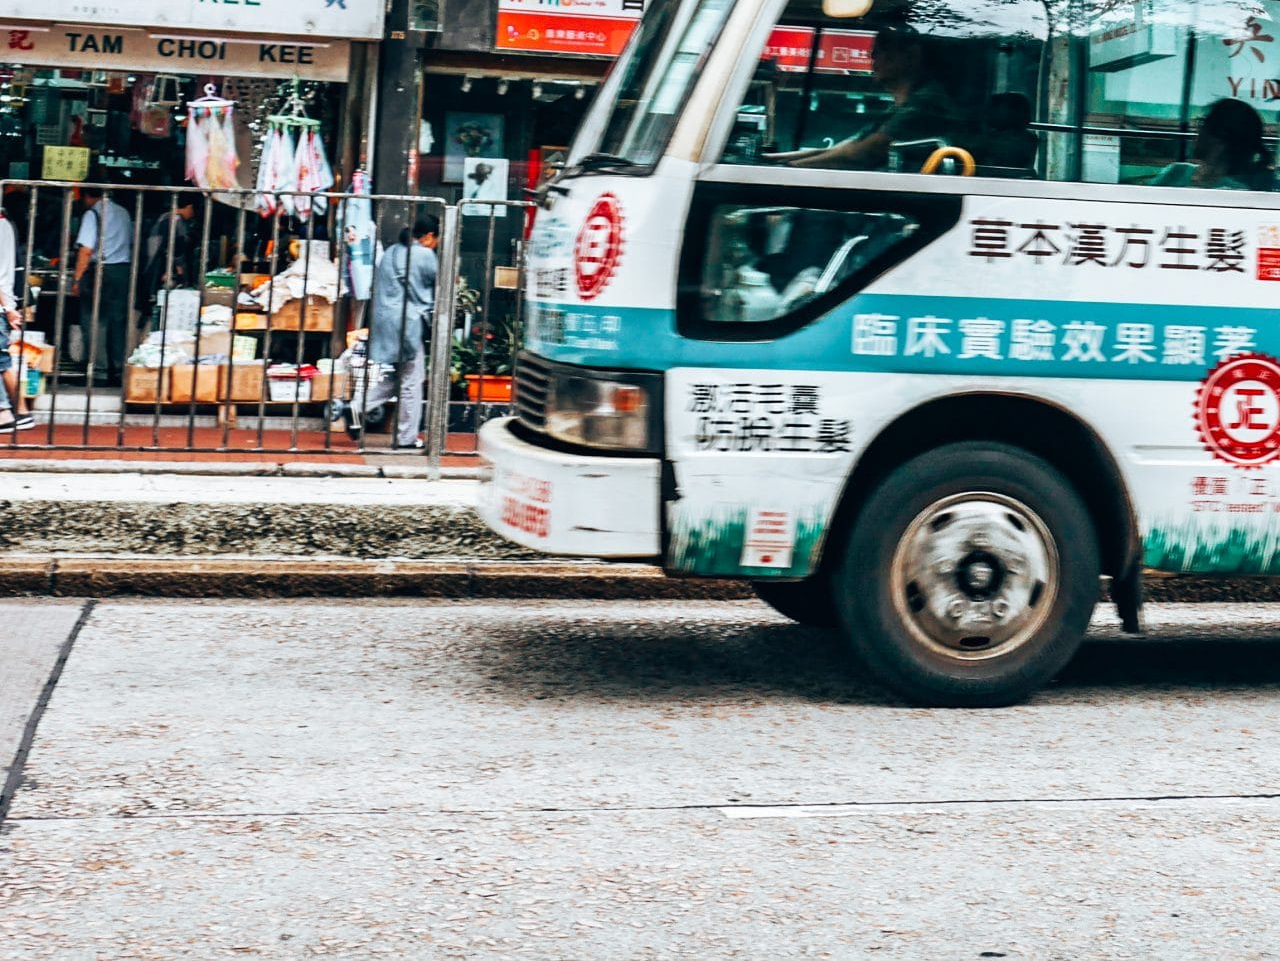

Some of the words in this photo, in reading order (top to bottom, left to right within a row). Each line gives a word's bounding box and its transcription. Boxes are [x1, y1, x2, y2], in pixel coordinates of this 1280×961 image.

[66, 33, 123, 54] TAM
[157, 39, 226, 60] CHOI
[259, 44, 314, 65] KEE
[968, 219, 1247, 274] 草本漢方生髮
[687, 383, 820, 415] 激活毛囊
